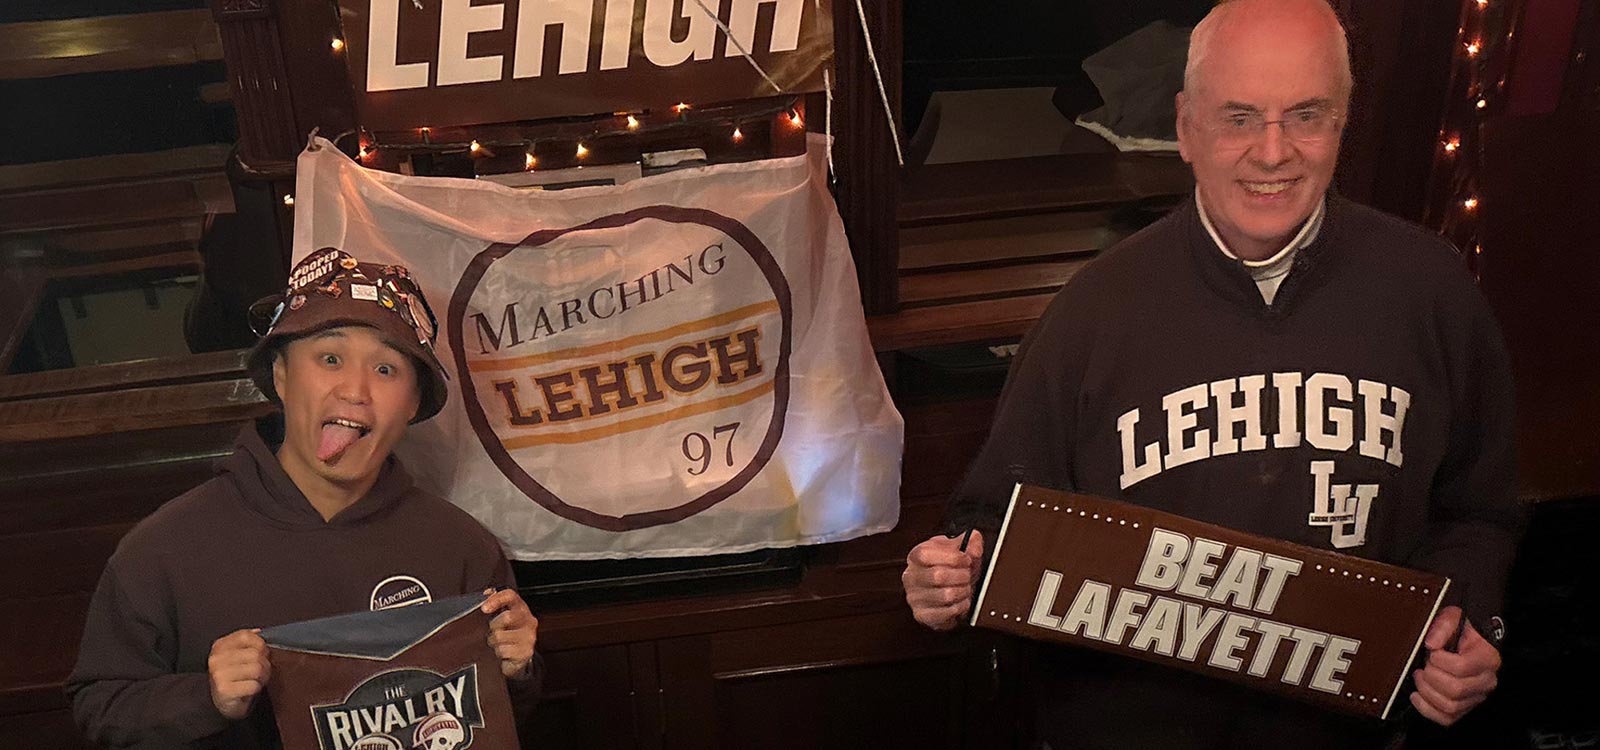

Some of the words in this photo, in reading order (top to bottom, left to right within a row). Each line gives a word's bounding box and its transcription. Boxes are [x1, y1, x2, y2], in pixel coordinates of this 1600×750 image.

[292, 262, 333, 290] TODAY!
[293, 250, 339, 279] POOPED
[470, 243, 726, 355] MARCHING
[494, 327, 765, 427] LEHIGH
[681, 422, 741, 476] 97
[1117, 372, 1410, 490] LEHIGH
[374, 585, 420, 610] MARCHING
[1135, 527, 1303, 615] BEAT
[1027, 569, 1360, 695] LAFAYETTE
[326, 675, 466, 750] RIVALRY
[384, 685, 409, 700] THE
